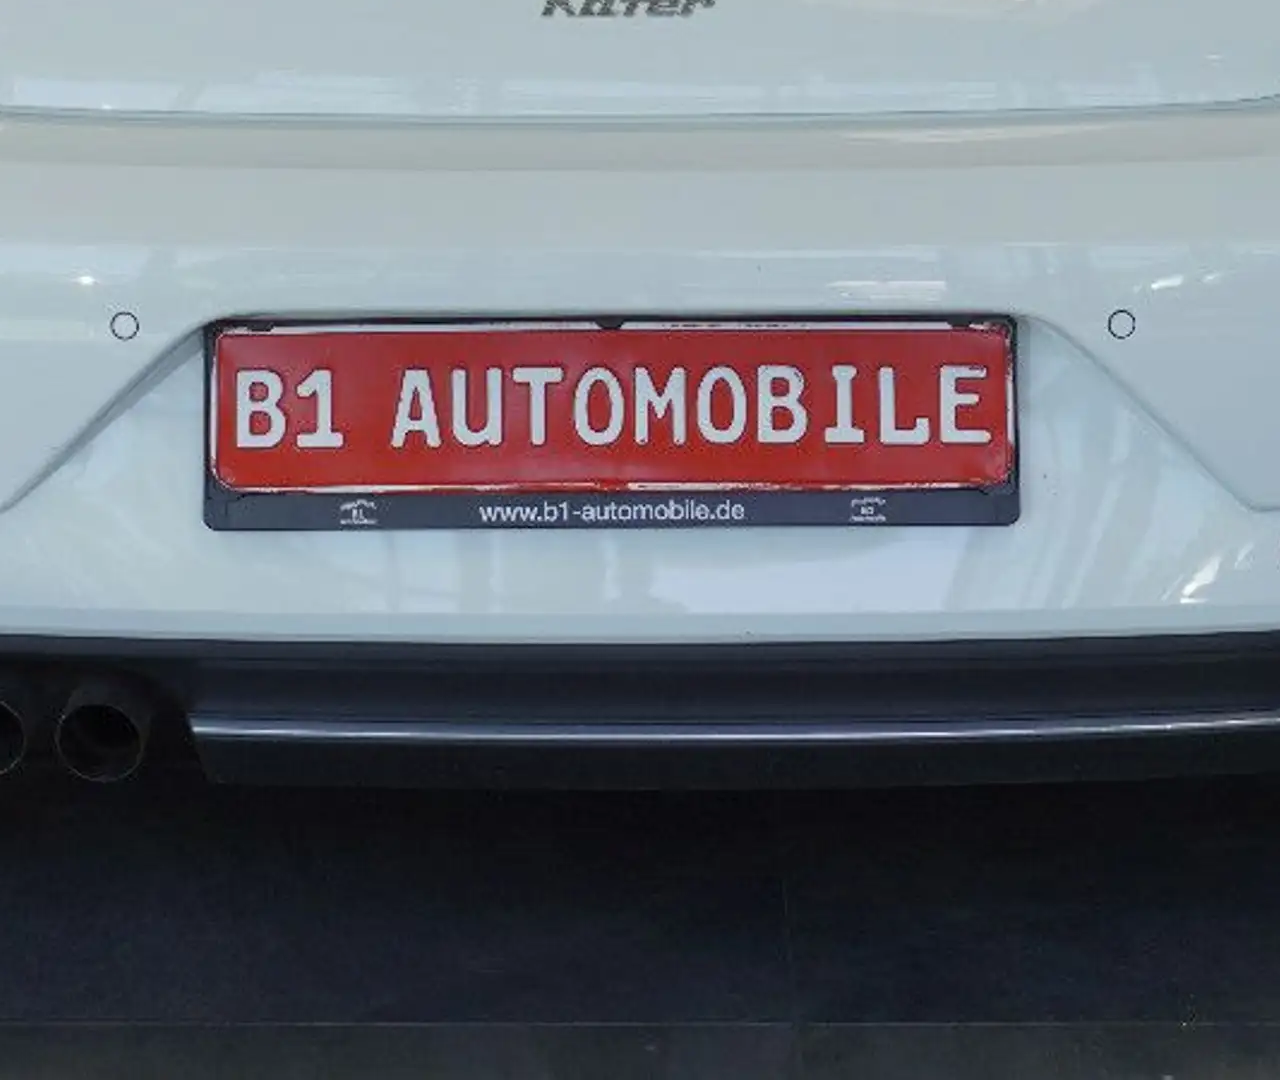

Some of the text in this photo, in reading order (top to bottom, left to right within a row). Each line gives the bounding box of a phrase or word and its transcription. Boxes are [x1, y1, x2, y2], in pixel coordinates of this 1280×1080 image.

[235, 363, 992, 448] B1 AUTOMOBILE
[478, 500, 745, 522] www.b1-automobile.de
